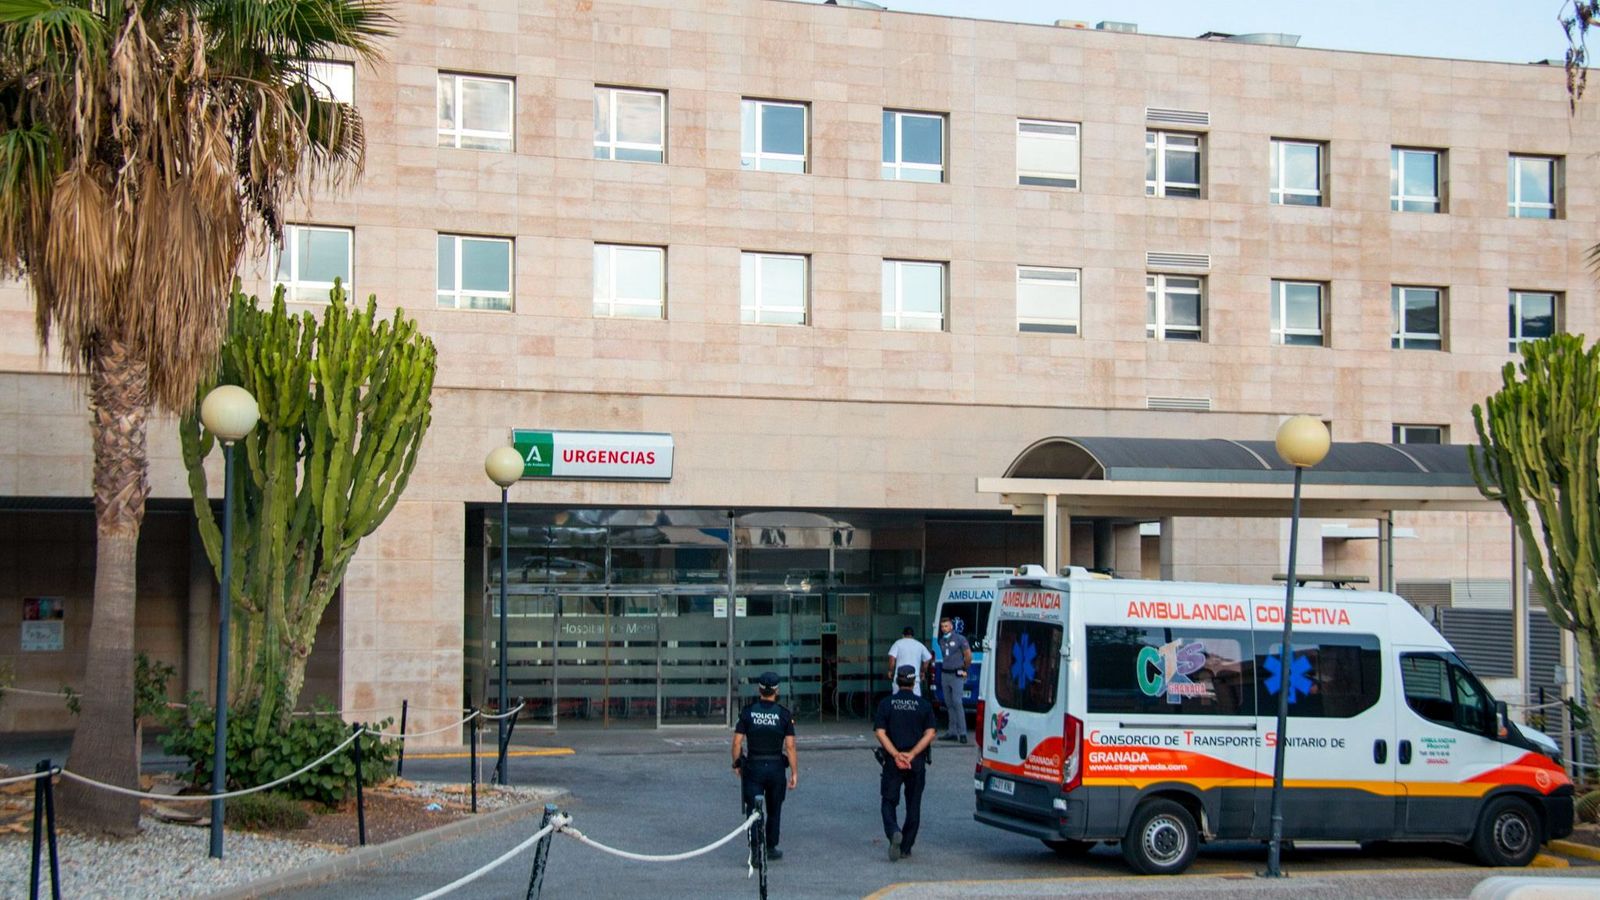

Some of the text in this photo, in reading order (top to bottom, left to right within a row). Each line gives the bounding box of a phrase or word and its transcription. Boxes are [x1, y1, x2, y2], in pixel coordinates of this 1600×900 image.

[562, 449, 656, 465] URGENCIAS
[1001, 591, 1061, 609] AMBULANCIA
[1127, 601, 1350, 625] AMBULANCIA COLECTIVA
[891, 699, 919, 707] POLICIA
[893, 704, 916, 712] LOCAL
[750, 711, 780, 720] POLICIA
[753, 718, 777, 726] LOCAL
[1089, 730, 1346, 748] CONSORCIO DE TRANSPORTE SNITARIO DE
[1088, 751, 1149, 763] GRANADA
[1089, 763, 1188, 773] www.ctsgranada.com
